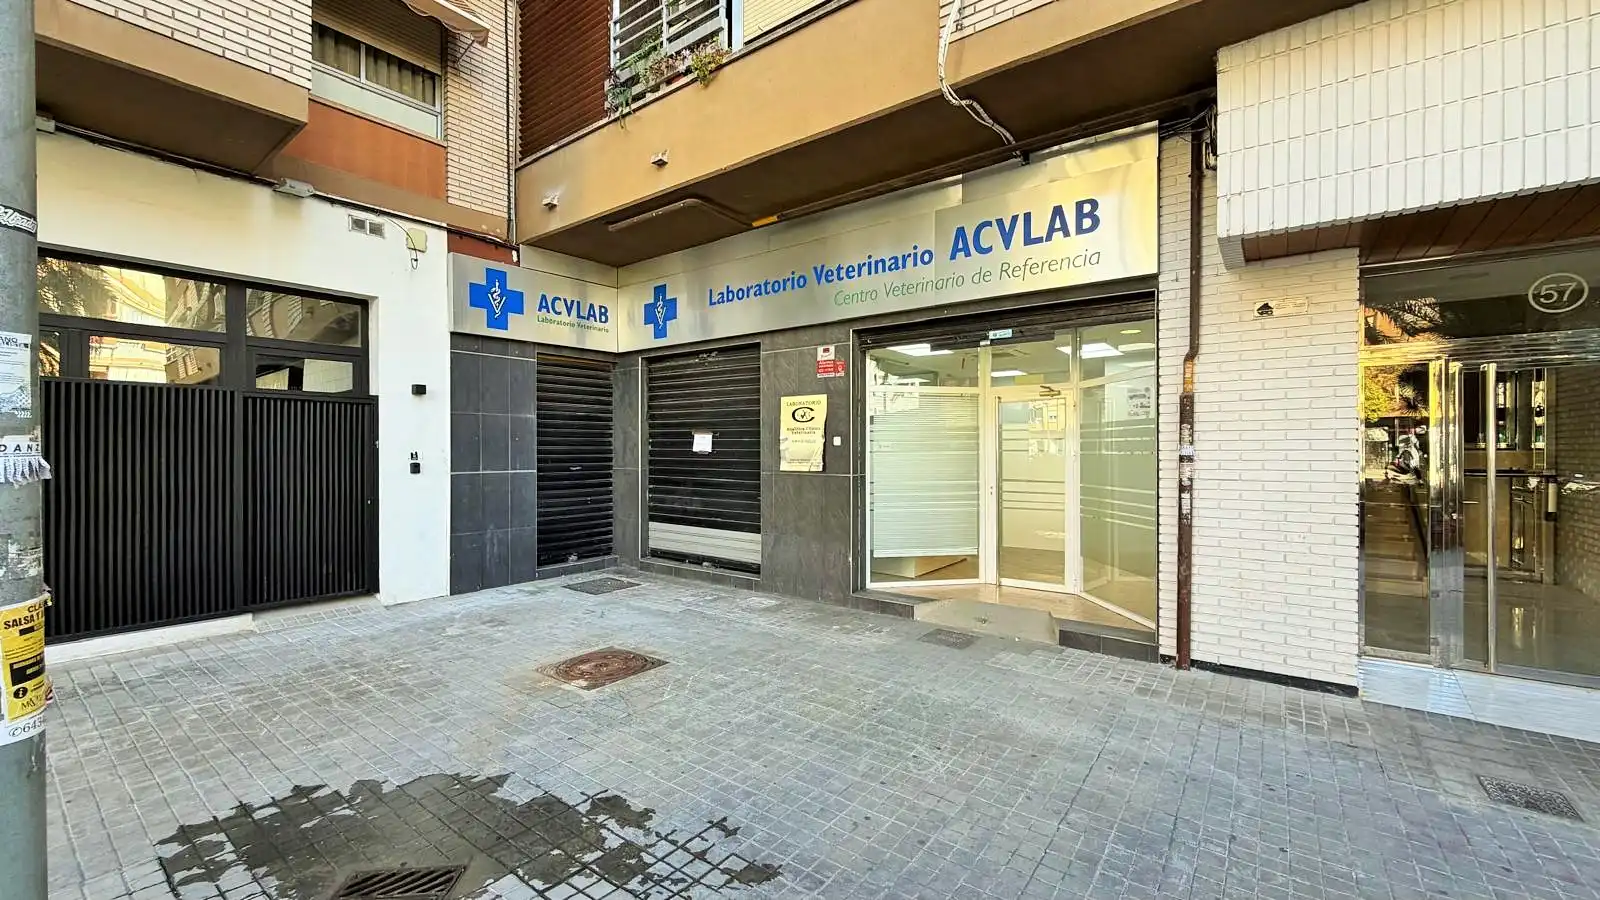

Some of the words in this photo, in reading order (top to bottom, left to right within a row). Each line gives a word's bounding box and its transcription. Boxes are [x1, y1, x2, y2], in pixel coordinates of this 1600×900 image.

[708, 271, 808, 306] Laboratorio
[813, 244, 934, 285] Veterinario
[949, 198, 1100, 262] ACVLAB
[833, 289, 878, 307] Centro
[883, 272, 965, 298] Veterinario
[971, 266, 993, 285] de
[999, 248, 1101, 281] Referencia
[1540, 282, 1577, 303] 57
[537, 293, 609, 324] ACVLAB
[537, 315, 576, 328] Laboratorio
[576, 320, 609, 333] Veterinario
[3, 613, 35, 630] SALSA
